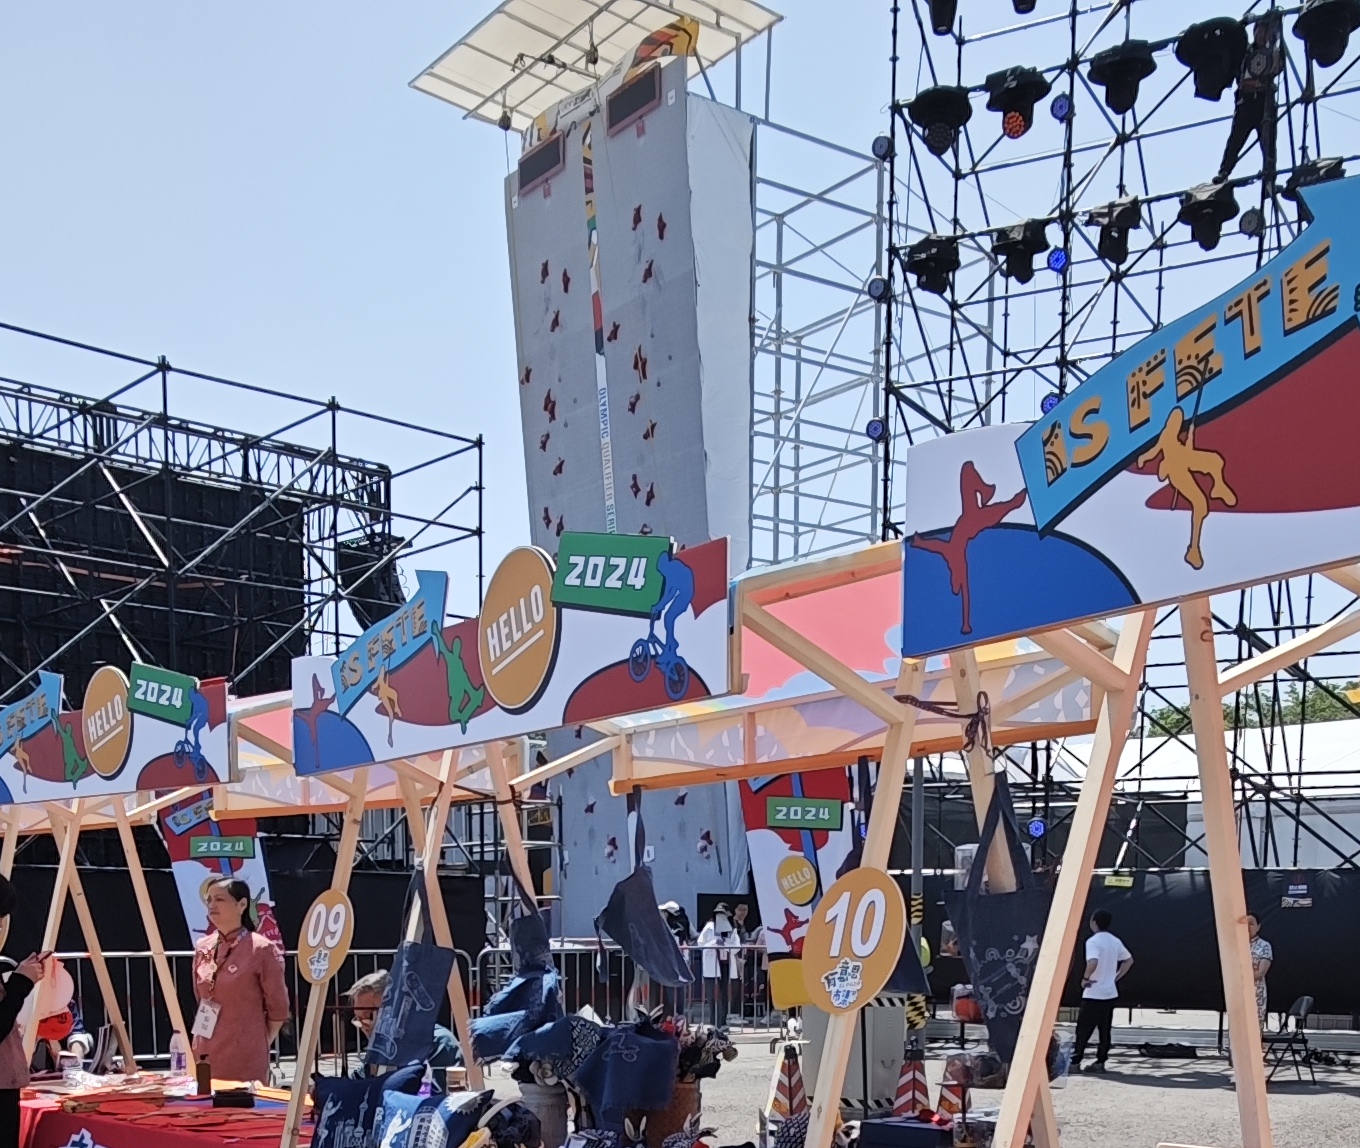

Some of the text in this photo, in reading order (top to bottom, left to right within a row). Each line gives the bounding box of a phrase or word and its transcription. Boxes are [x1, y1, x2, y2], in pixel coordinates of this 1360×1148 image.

[1042, 238, 1341, 487] IS FETE
[598, 387, 610, 439] OLYMPIC
[606, 503, 616, 533] SERI
[564, 555, 648, 590] 2024
[367, 599, 428, 673] FETE
[486, 583, 545, 662] HELLO
[134, 679, 183, 709] 2024
[87, 694, 124, 741] HELLO
[774, 806, 830, 821] 2024
[197, 841, 244, 852] 2024
[781, 867, 812, 891] HELLO
[307, 903, 346, 948] 09
[824, 888, 887, 958] 10
